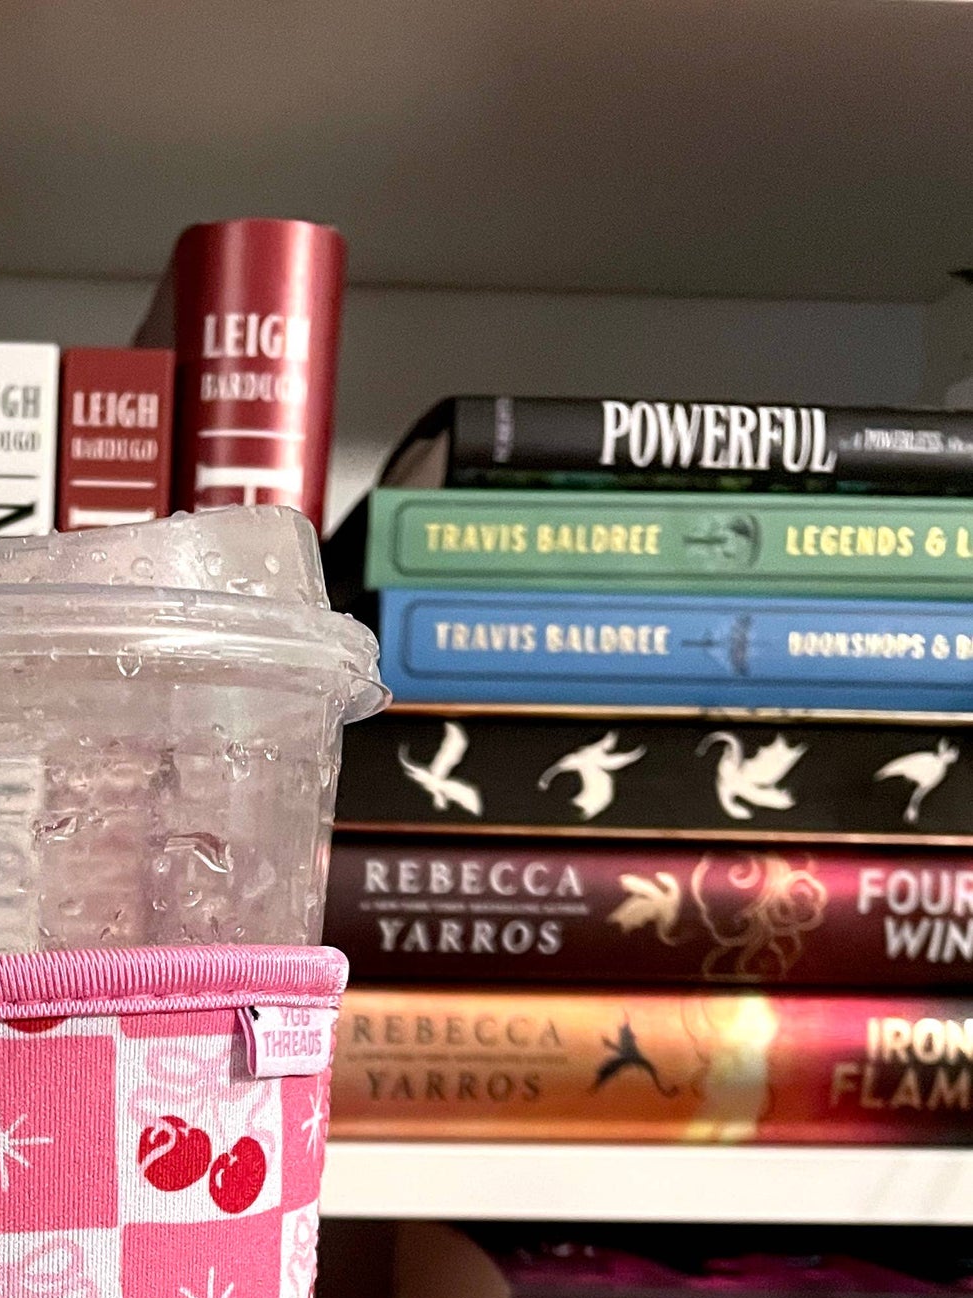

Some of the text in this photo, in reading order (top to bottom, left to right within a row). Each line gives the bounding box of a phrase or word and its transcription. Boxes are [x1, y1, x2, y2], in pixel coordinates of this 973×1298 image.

[202, 312, 311, 361] LEIGH
[71, 391, 159, 428] LEIGH
[70, 437, 159, 461] BARDUGO
[600, 400, 838, 474] POWERFUL
[424, 522, 663, 556] TRAVIS BALDREE
[785, 525, 915, 557] LEGENDS
[925, 526, 947, 558] &
[435, 621, 672, 657] TRAVIS BALDREE
[787, 630, 926, 660] BOOKSHOPS
[931, 633, 951, 661] &
[363, 859, 584, 896] REBECCA
[378, 918, 563, 955] YARROS
[262, 1029, 323, 1058] THREADS
[351, 1014, 564, 1047] REBECCA
[865, 1016, 973, 1066] IRON
[365, 1068, 542, 1103] YARROS
